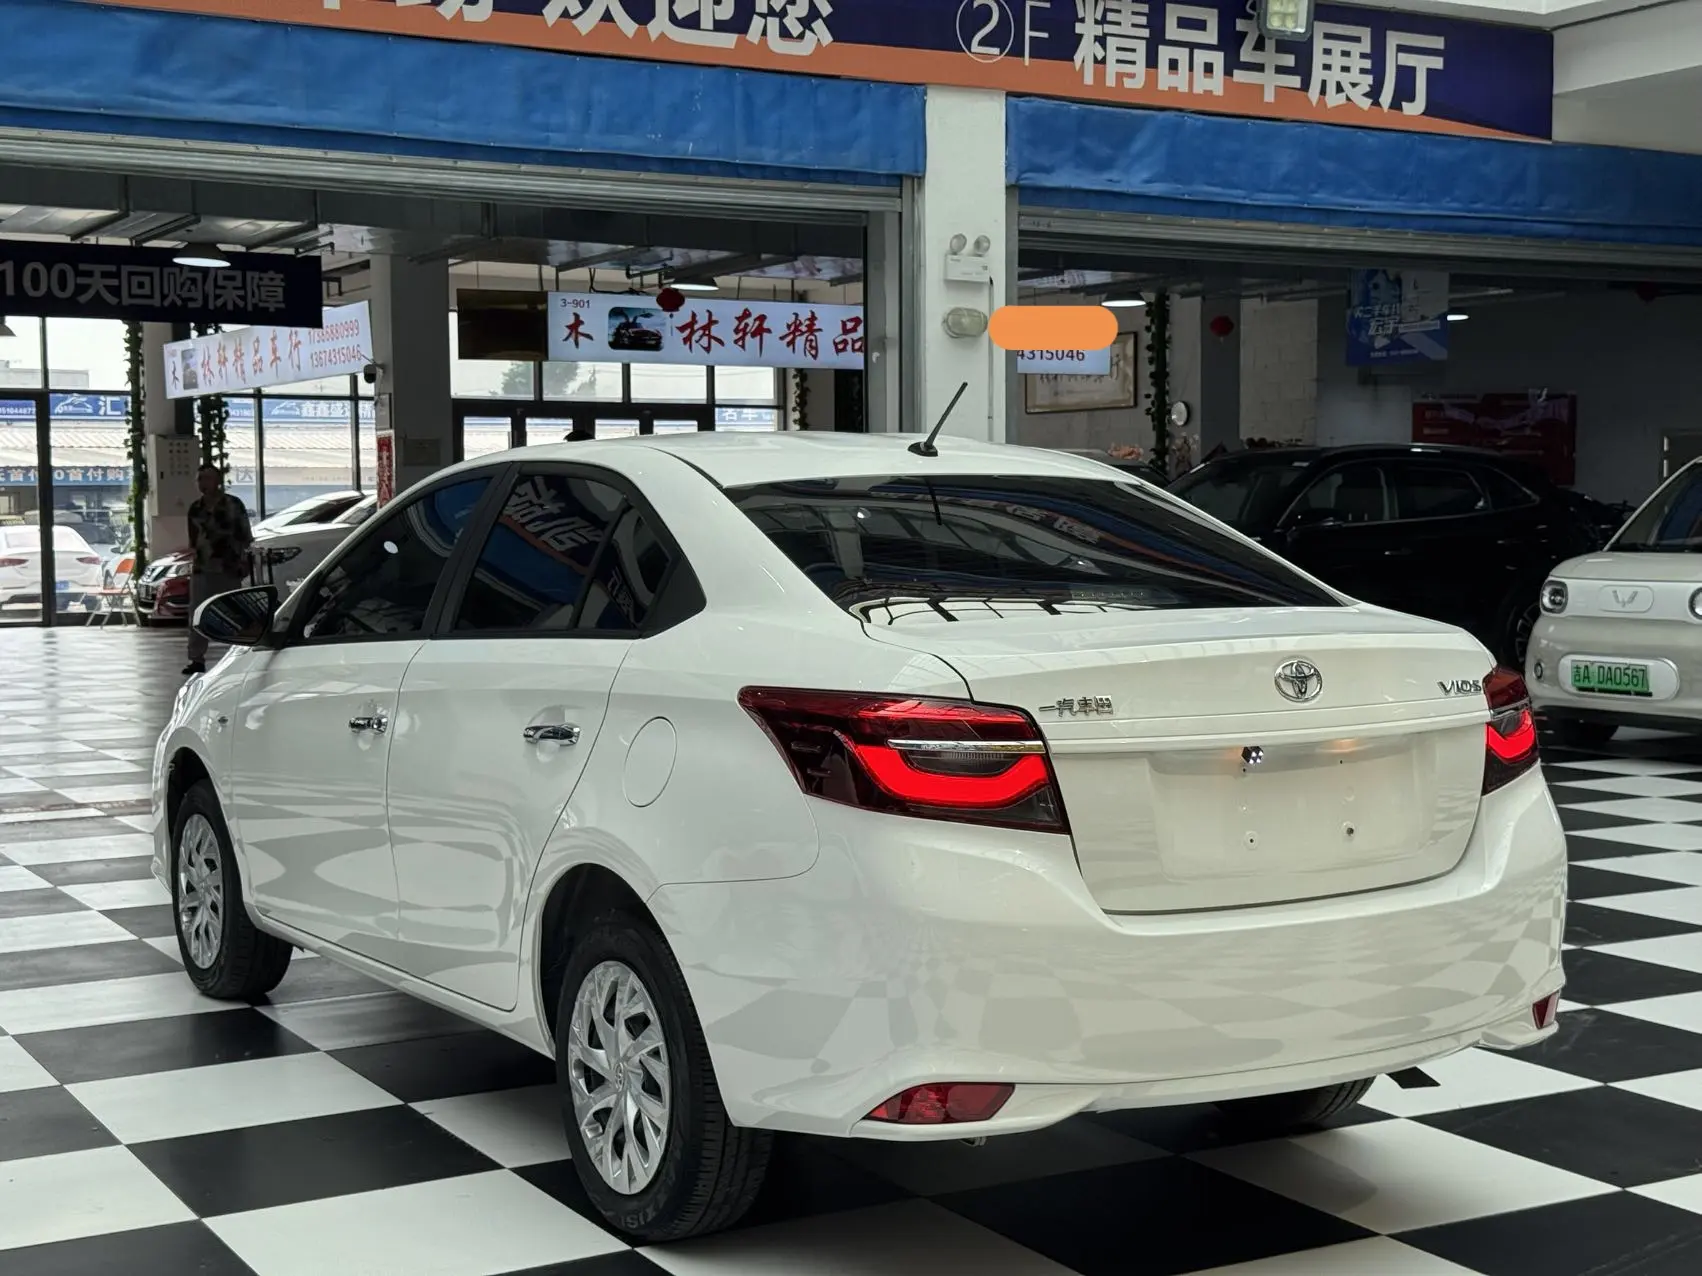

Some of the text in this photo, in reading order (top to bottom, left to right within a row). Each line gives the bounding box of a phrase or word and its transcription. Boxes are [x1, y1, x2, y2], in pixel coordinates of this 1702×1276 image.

[1073, 0, 1446, 117] 精品车展厅
[0, 259, 286, 313] 100天回购保障
[560, 298, 591, 309] 3-901
[562, 307, 865, 361] 木 林轩精品
[1437, 680, 1482, 695] VIOS
[1039, 696, 1113, 718] 一汽丰田
